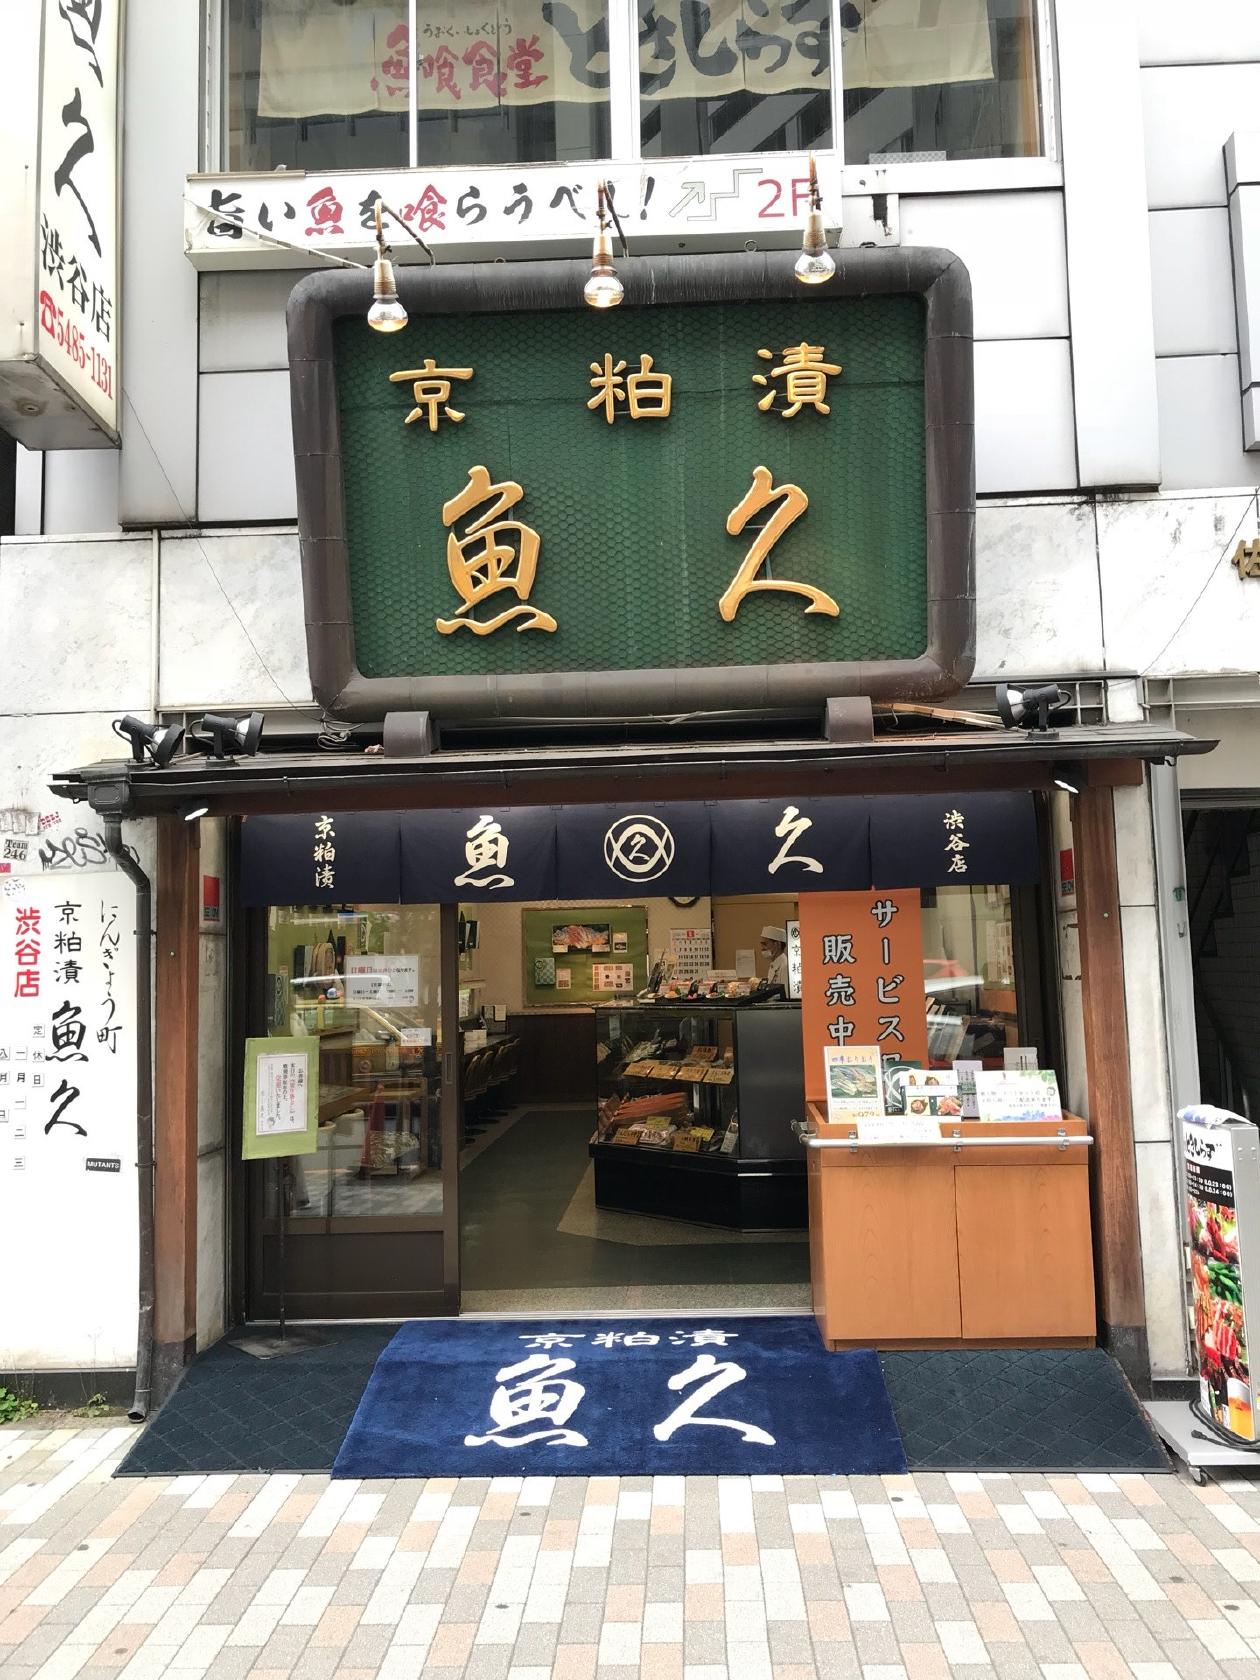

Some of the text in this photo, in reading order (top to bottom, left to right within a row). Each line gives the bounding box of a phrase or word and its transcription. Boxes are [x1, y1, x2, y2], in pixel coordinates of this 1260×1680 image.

[41, 212, 113, 344] 渋谷店
[56, 310, 113, 401] 5485-1131
[389, 342, 843, 432] 京粕漬
[436, 465, 841, 636] 魚久
[3, 848, 27, 861] 246
[313, 815, 336, 889] 京粕漬
[943, 809, 971, 874] 渋谷店
[14, 907, 41, 998] 渋谷店
[53, 900, 83, 985] 京粕漬
[823, 933, 857, 1046] 販売中
[45, 1000, 89, 1137] 魚久
[87, 1159, 120, 1170] MUTANTS
[518, 1329, 739, 1349] 京粕漬
[463, 1353, 777, 1448] 魚久
